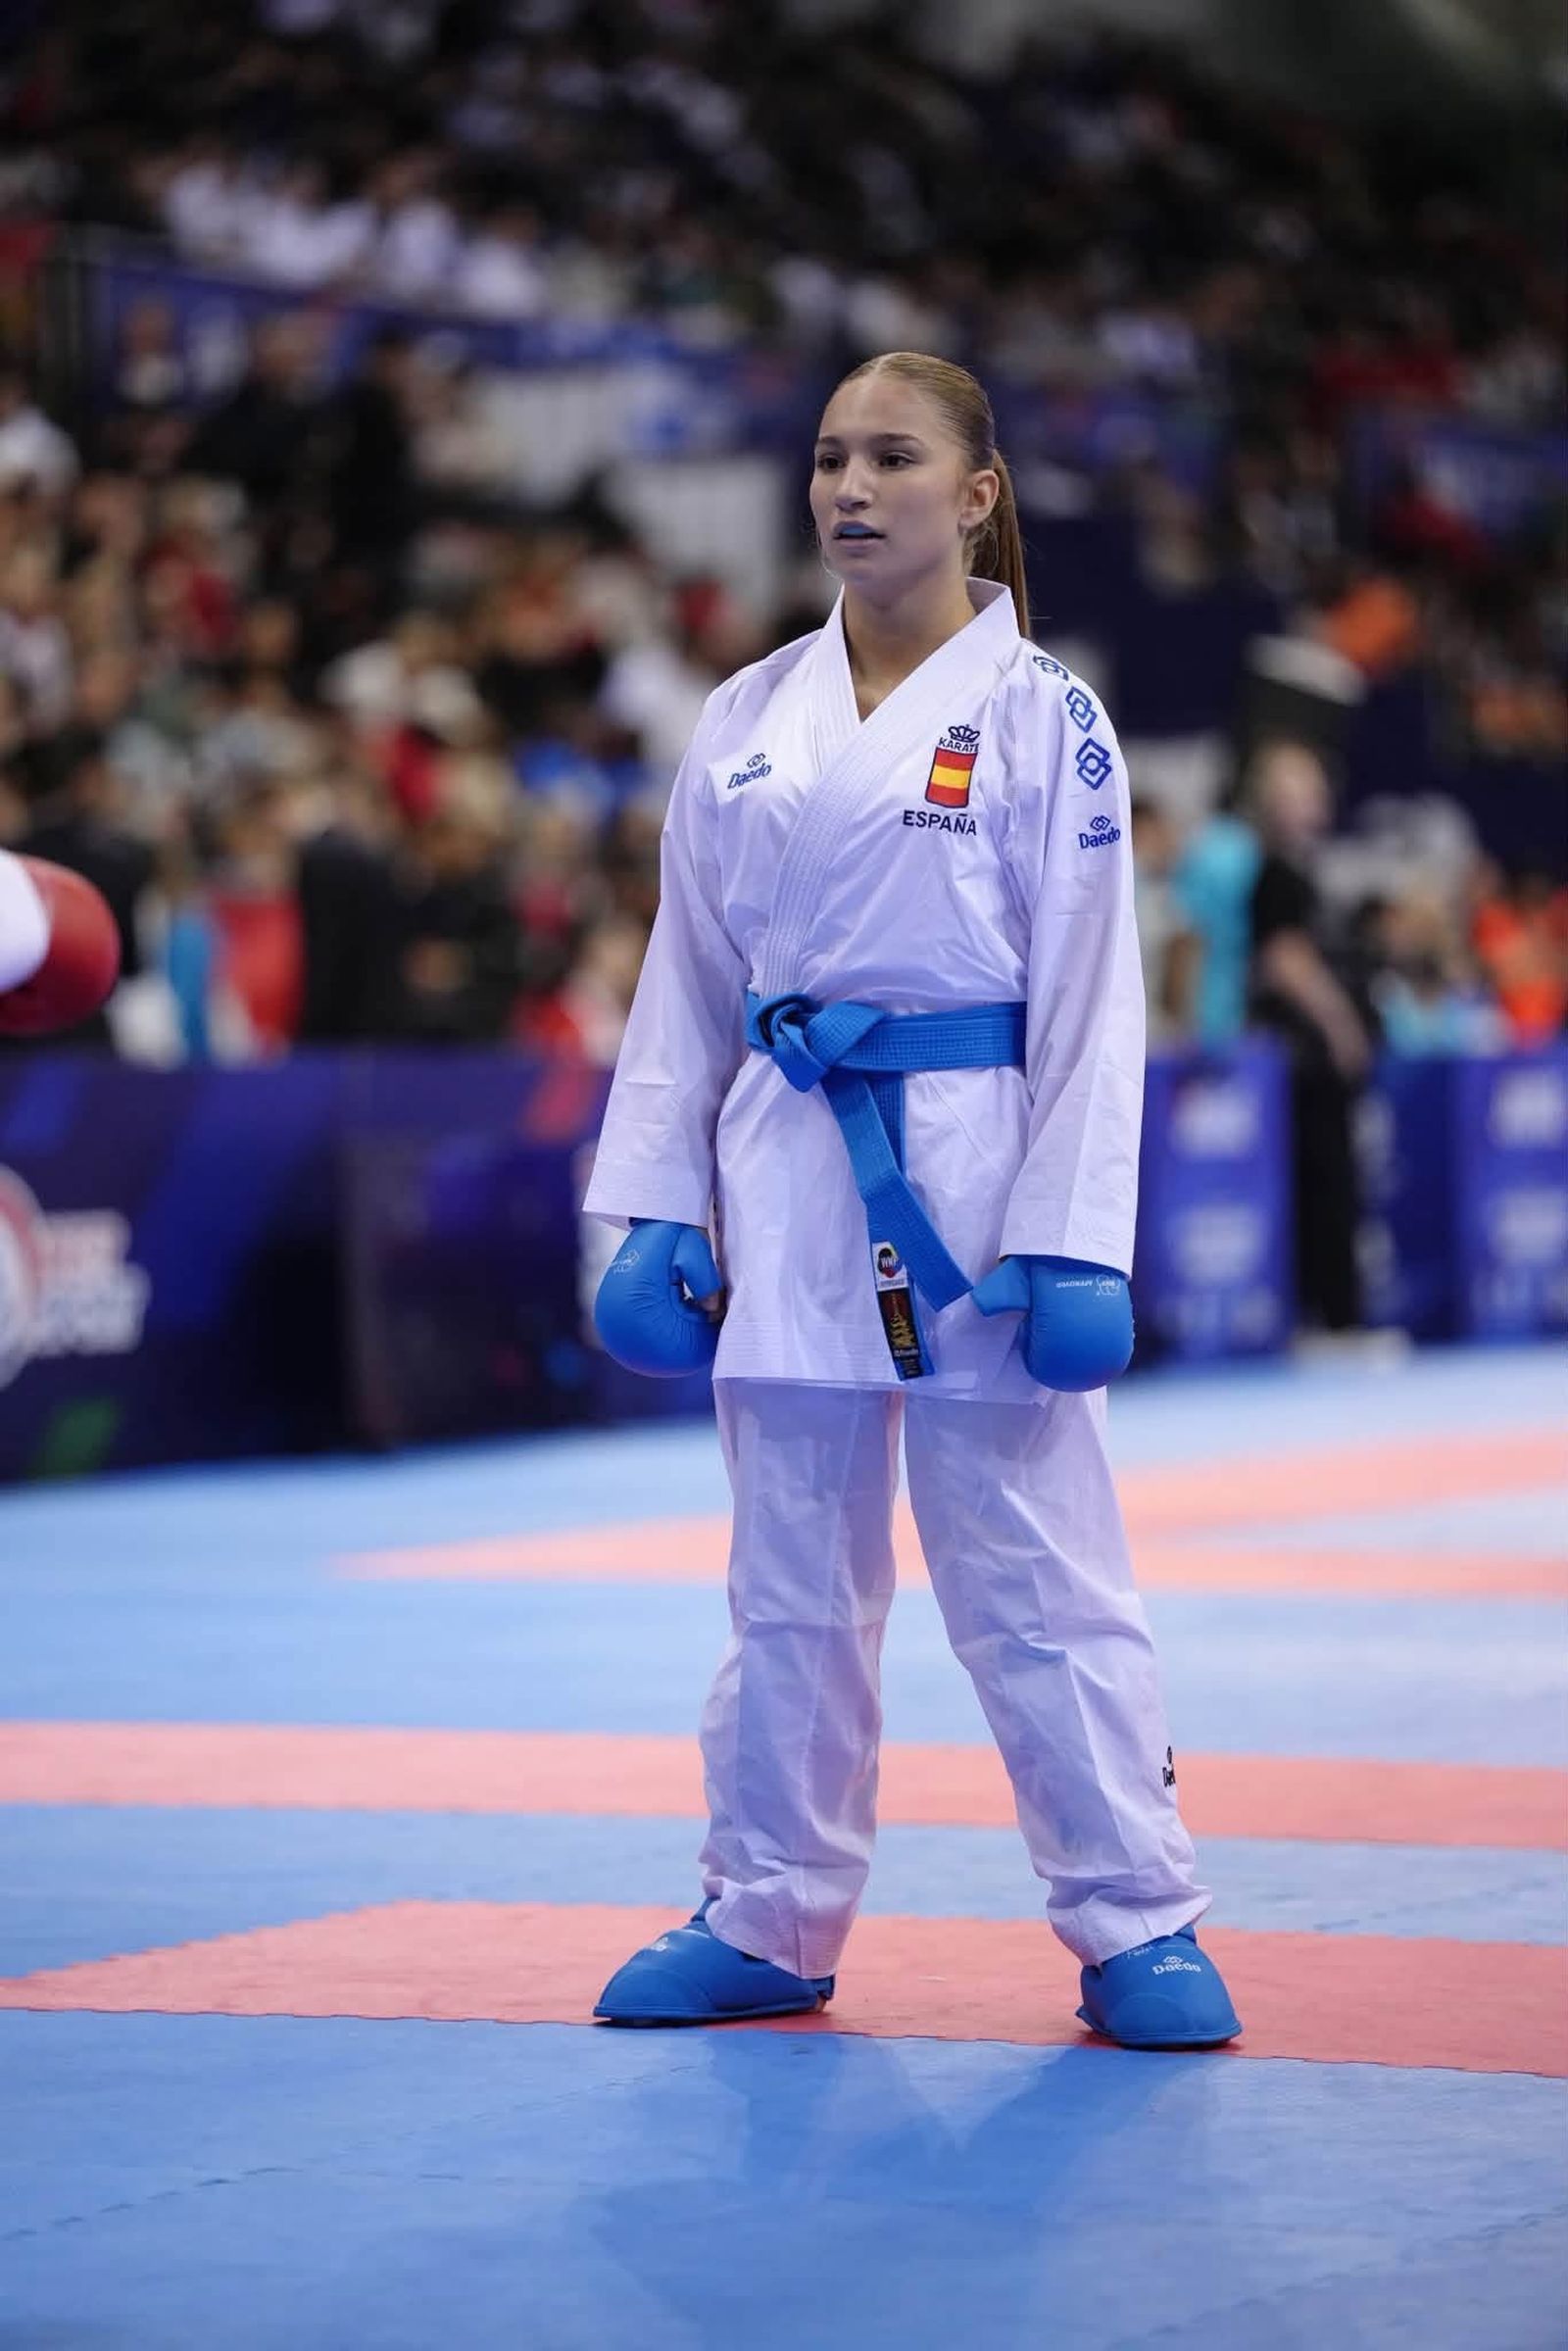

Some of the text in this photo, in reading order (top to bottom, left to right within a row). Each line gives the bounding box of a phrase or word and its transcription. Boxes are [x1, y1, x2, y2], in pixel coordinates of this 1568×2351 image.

[727, 762, 772, 789] Daedo
[903, 809, 977, 836] ESPAÑA
[1078, 826, 1121, 849] Daedo
[1152, 1962, 1201, 1976] Daedo
